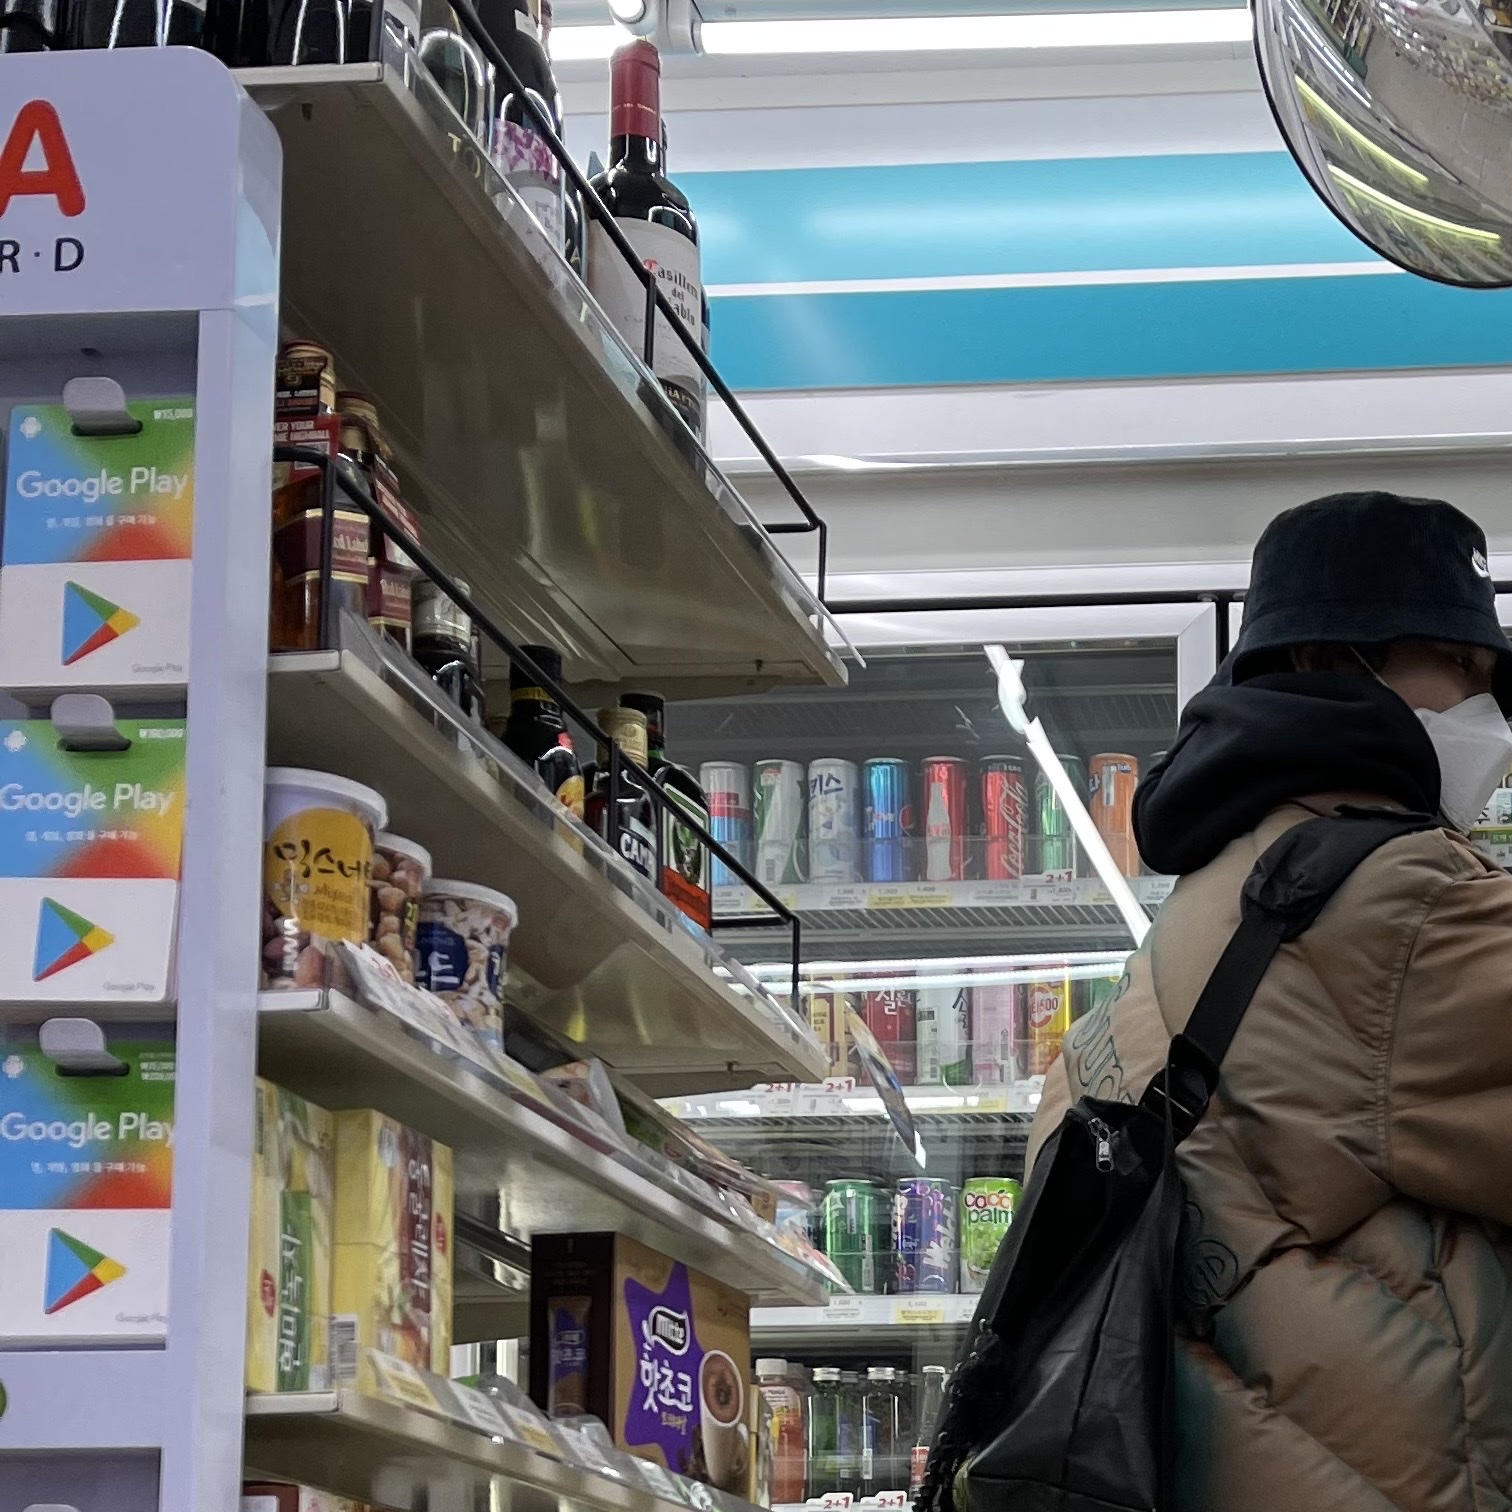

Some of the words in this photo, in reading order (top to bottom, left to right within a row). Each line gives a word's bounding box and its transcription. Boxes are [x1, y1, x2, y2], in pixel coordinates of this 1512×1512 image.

[16, 467, 124, 503] Google
[130, 466, 188, 499] Play
[0, 783, 107, 818] Google
[113, 782, 174, 816] Play
[1045, 870, 1073, 884] 2+1
[825, 1079, 853, 1093] 2+1
[0, 1112, 112, 1148] Google
[118, 1111, 174, 1147] Play
[407, 1158, 431, 1291] 둥굴레차
[967, 1207, 1015, 1226] palm
[823, 1495, 850, 1510] 2+1
[878, 1494, 905, 1509] 2+1
